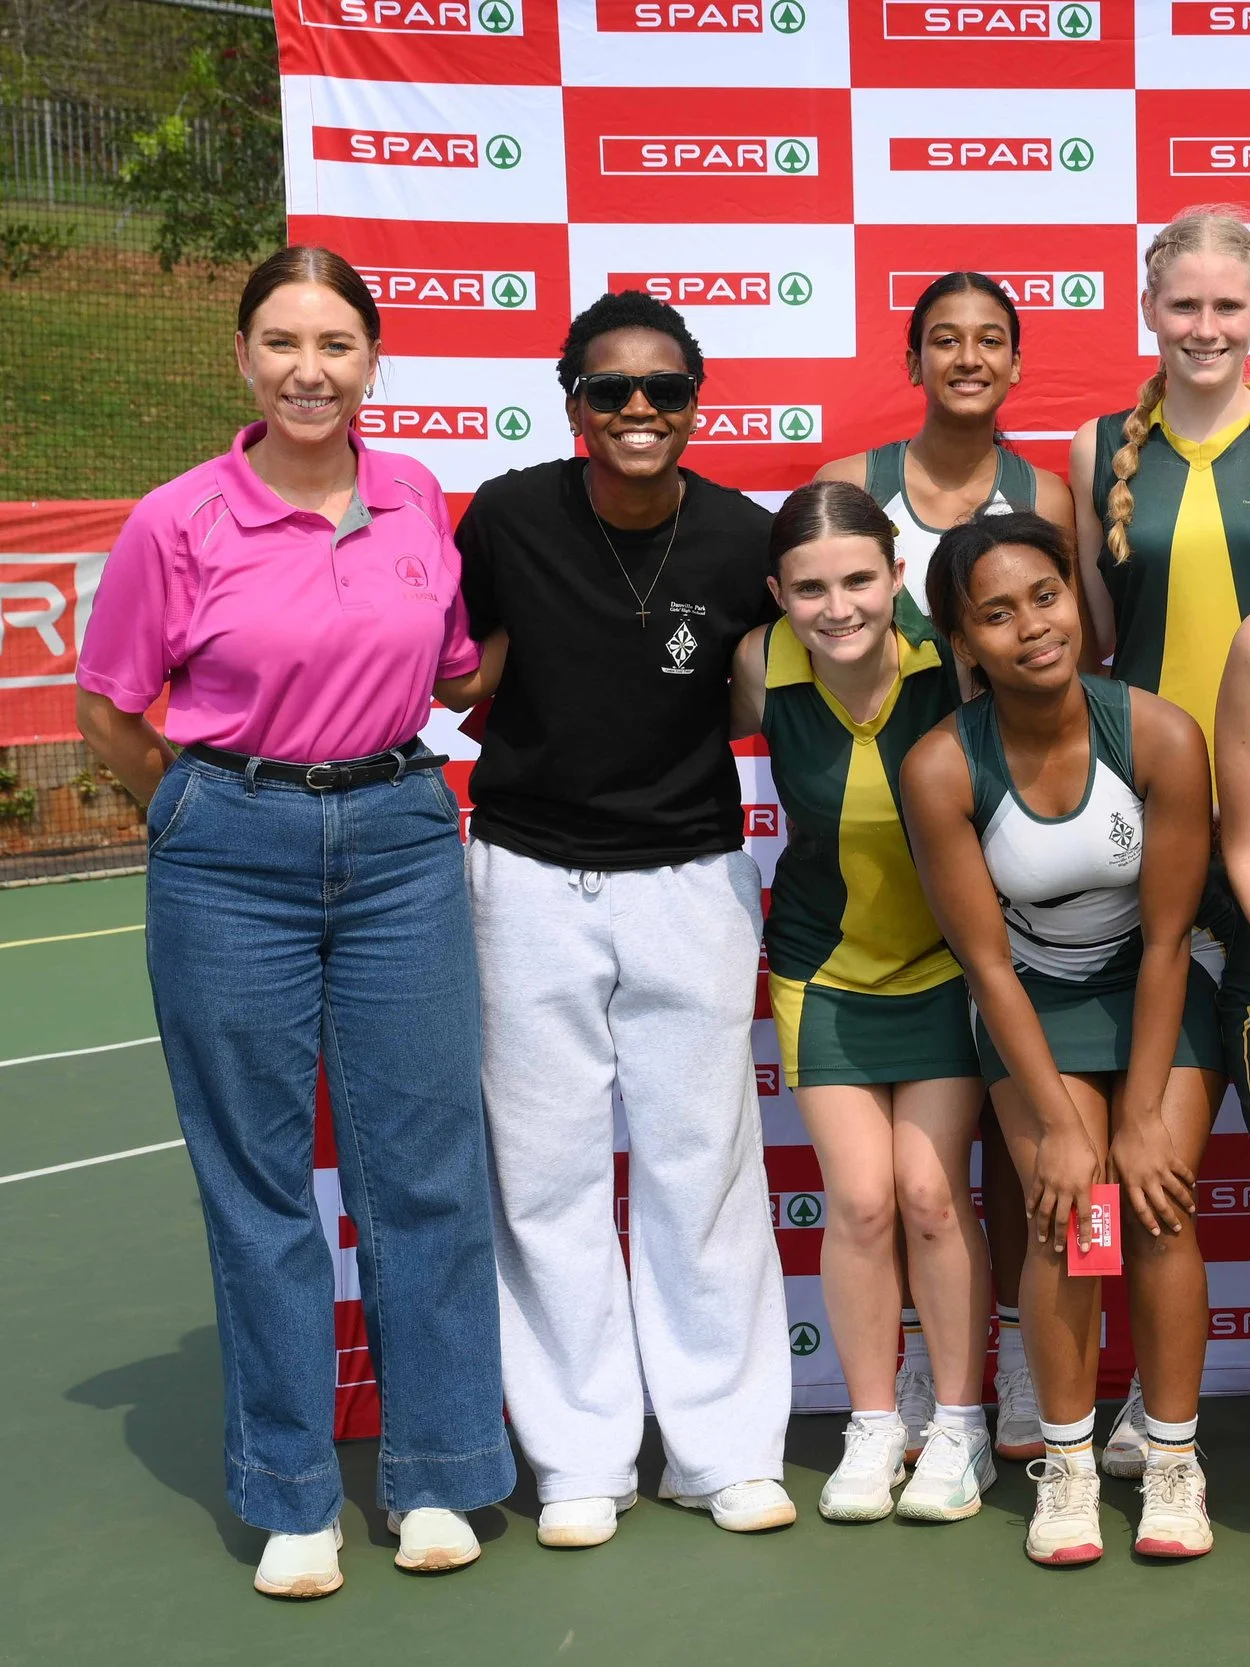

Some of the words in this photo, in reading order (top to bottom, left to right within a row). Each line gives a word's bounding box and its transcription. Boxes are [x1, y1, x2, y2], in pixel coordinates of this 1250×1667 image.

[340, 0, 468, 27] SPAR
[635, 3, 760, 28] SPAR
[924, 8, 1047, 32] SPAR
[350, 134, 475, 163] SPAR
[641, 144, 764, 168] SPAR
[927, 143, 1049, 166] SPAR
[361, 275, 481, 302] SPAR
[645, 277, 767, 301] SPAR
[999, 279, 1051, 302] AR
[359, 409, 485, 435] SPAR
[697, 413, 769, 436] AR
[1091, 1204, 1104, 1248] GIFT
